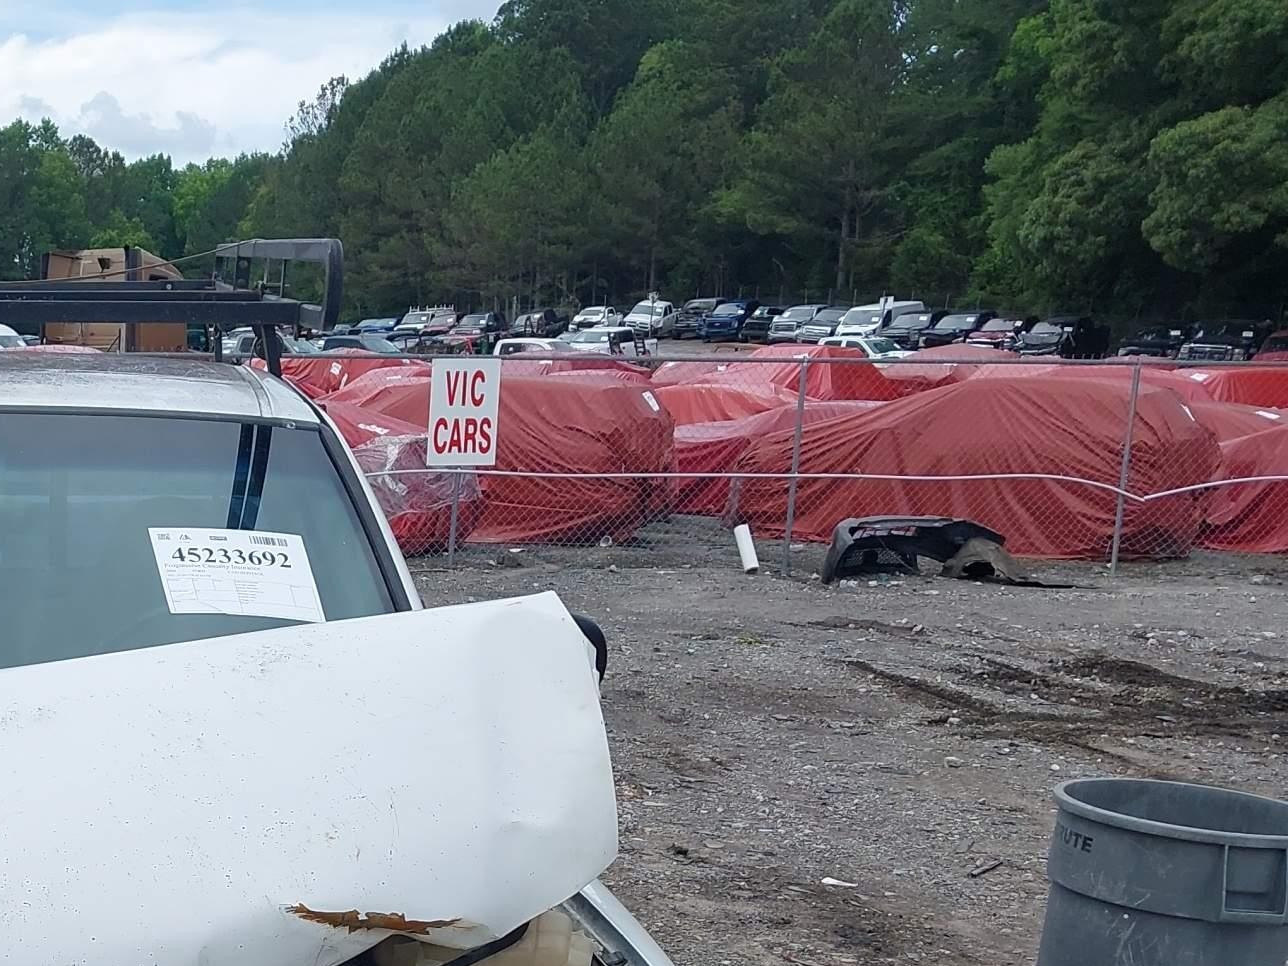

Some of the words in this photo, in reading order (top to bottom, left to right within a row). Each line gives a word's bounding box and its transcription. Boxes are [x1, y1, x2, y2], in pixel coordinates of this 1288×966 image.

[446, 369, 486, 407] VIC
[433, 417, 492, 454] CARS
[172, 547, 292, 568] 45233692
